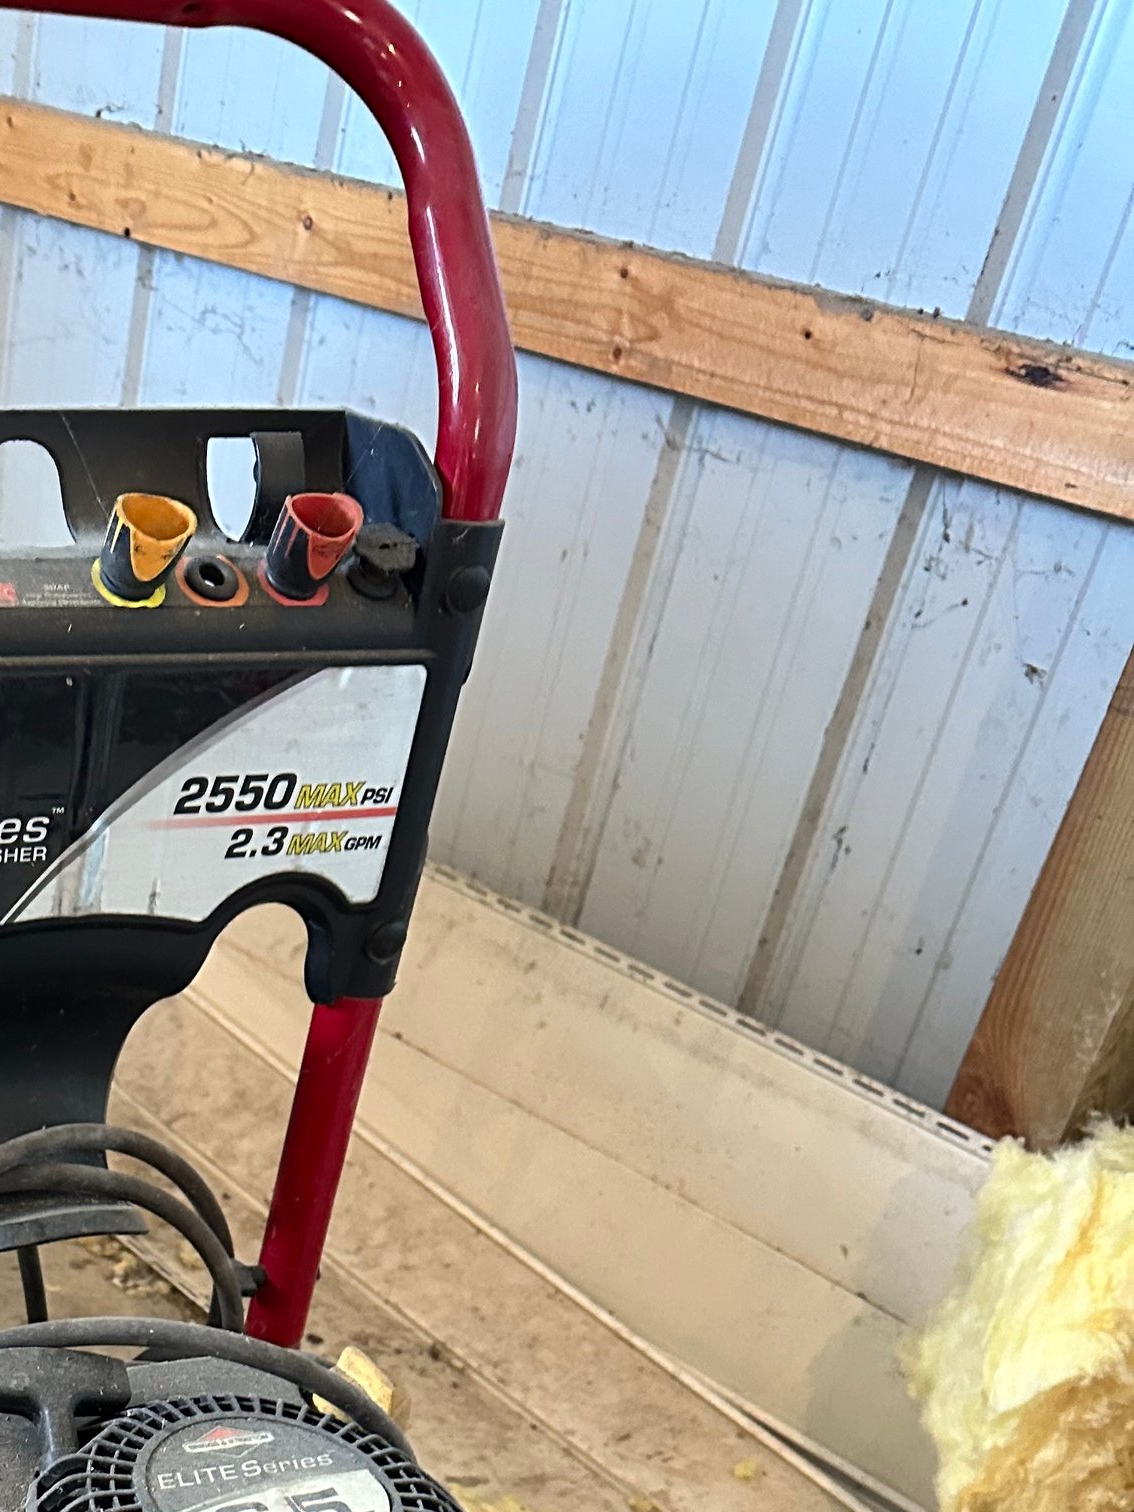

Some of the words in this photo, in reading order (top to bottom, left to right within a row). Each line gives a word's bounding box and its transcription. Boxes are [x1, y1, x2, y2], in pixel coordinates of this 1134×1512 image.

[173, 773, 298, 815] 2550
[293, 780, 366, 809] MAX
[361, 787, 394, 805] PSI
[224, 826, 289, 859] 2.3
[286, 831, 349, 856] MAX
[343, 835, 383, 851] GPM
[157, 1464, 238, 1490] ELITE
[241, 1452, 334, 1478] Series
